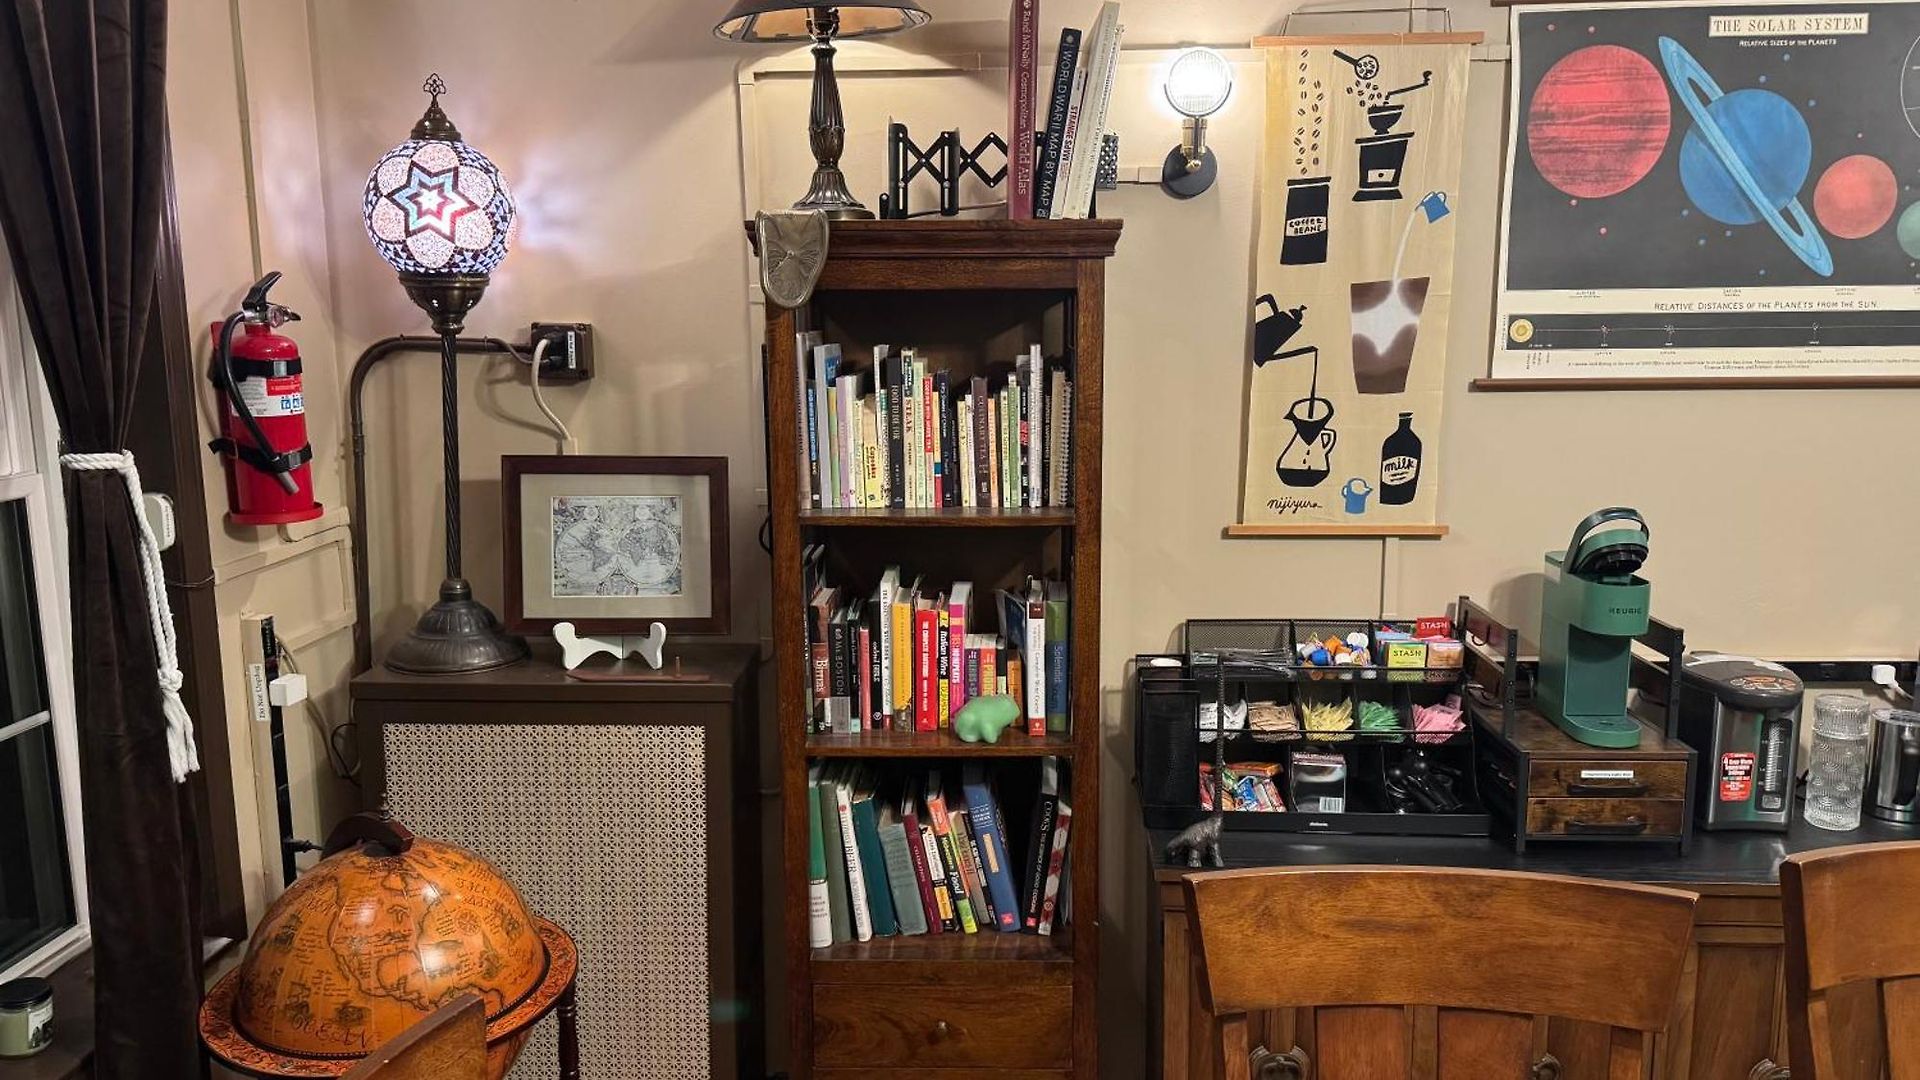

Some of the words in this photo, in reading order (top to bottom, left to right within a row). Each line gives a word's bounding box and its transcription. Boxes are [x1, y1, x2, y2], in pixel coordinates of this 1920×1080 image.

[1021, 12, 1031, 33] Rand
[1714, 19, 1741, 33] THE
[1748, 18, 1796, 32] SOLAR
[1804, 17, 1864, 31] SYSTEM
[1020, 35, 1031, 68] McNally
[1058, 50, 1073, 94] WORLD
[1053, 95, 1067, 121] WAR
[1018, 131, 1030, 163] World
[1048, 132, 1060, 159] MAP
[1045, 161, 1056, 176] BY
[1018, 168, 1029, 194] Atlas
[1041, 179, 1053, 206] MAP
[1293, 223, 1324, 235] BEANS
[1654, 302, 1693, 311] RELATIVE
[1697, 302, 1744, 310] DISTANCES
[1774, 301, 1814, 309] PLANETS
[1384, 458, 1416, 474] milk
[1420, 621, 1448, 631] STASH
[940, 630, 949, 655] Italian
[1393, 649, 1422, 658] STASH
[835, 656, 845, 695] BOSTON
[940, 656, 949, 676] Wine
[949, 871, 964, 894] Food
